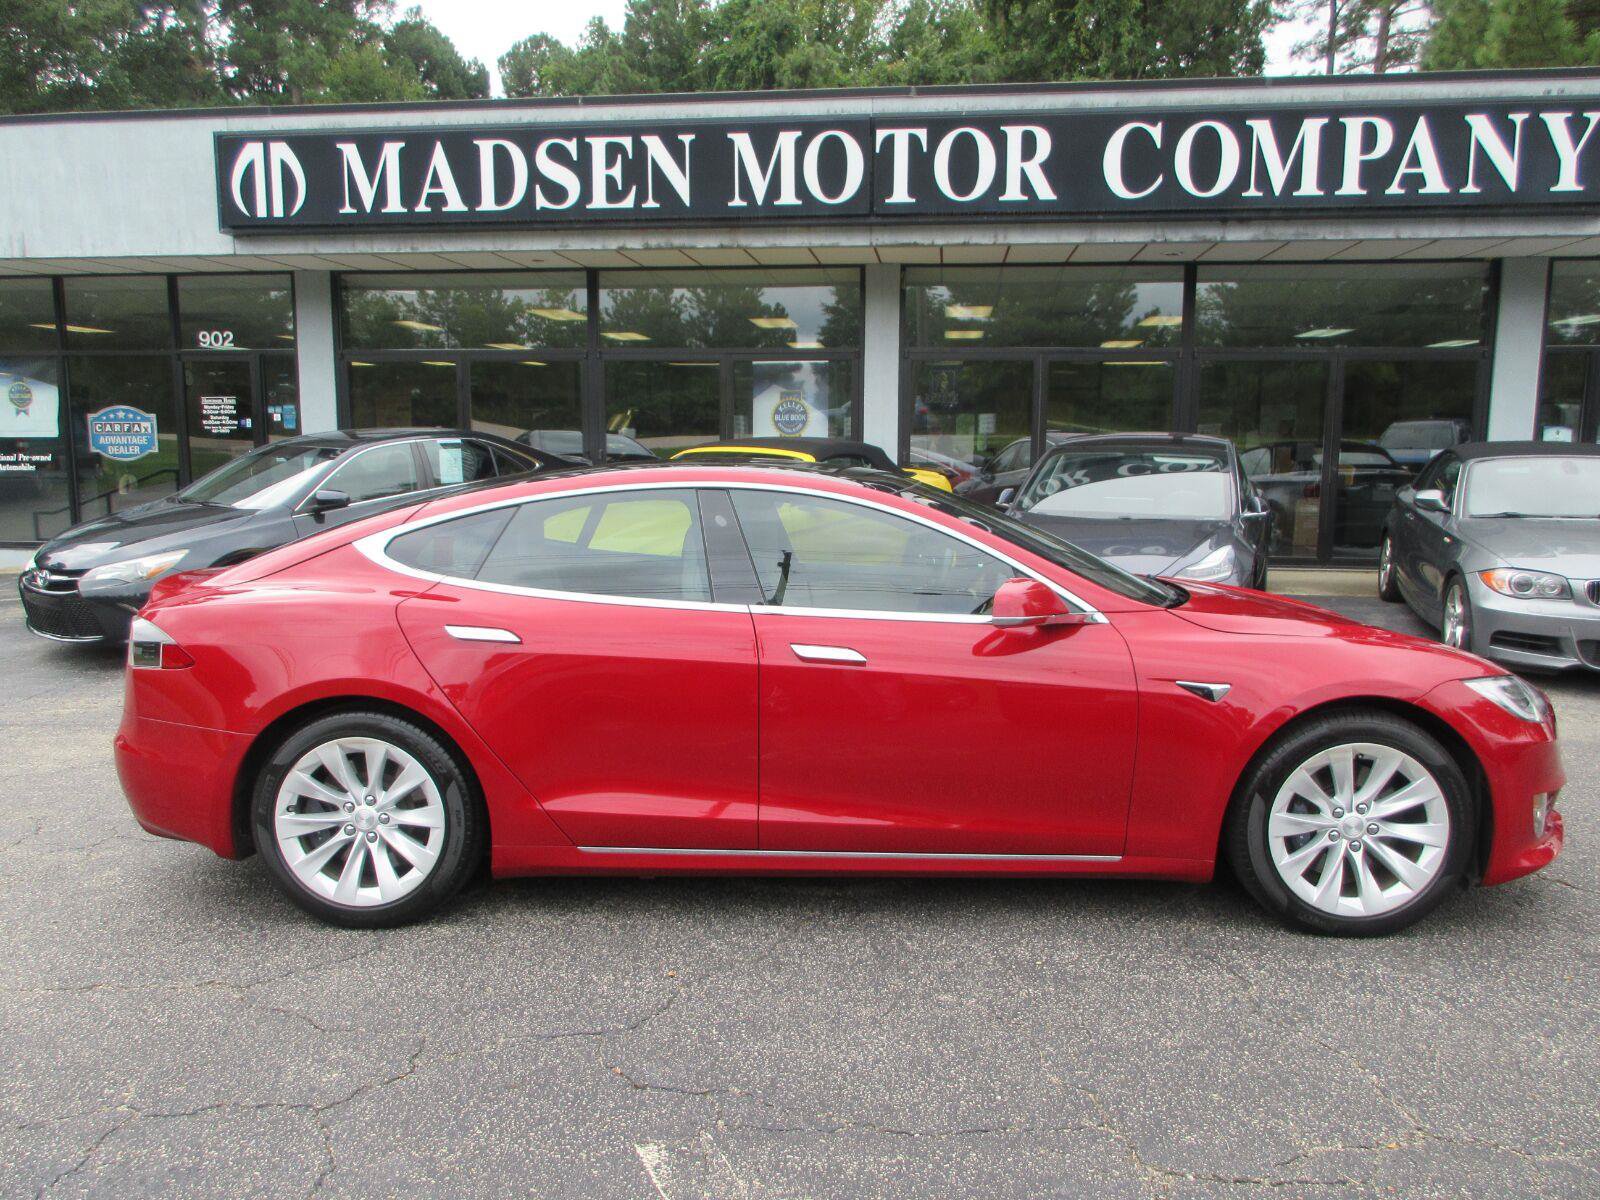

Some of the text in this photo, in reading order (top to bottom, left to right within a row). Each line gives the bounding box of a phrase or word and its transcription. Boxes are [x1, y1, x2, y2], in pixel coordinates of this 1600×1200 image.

[335, 111, 1600, 215] MADSEN MOTOR COMPANY
[198, 330, 235, 347] 902
[778, 402, 804, 412] KELLEY
[95, 421, 152, 434] CARFAX
[99, 435, 149, 445] ADVANTAGE
[108, 445, 141, 455] DEALER
[18, 453, 52, 462] Pre-owned
